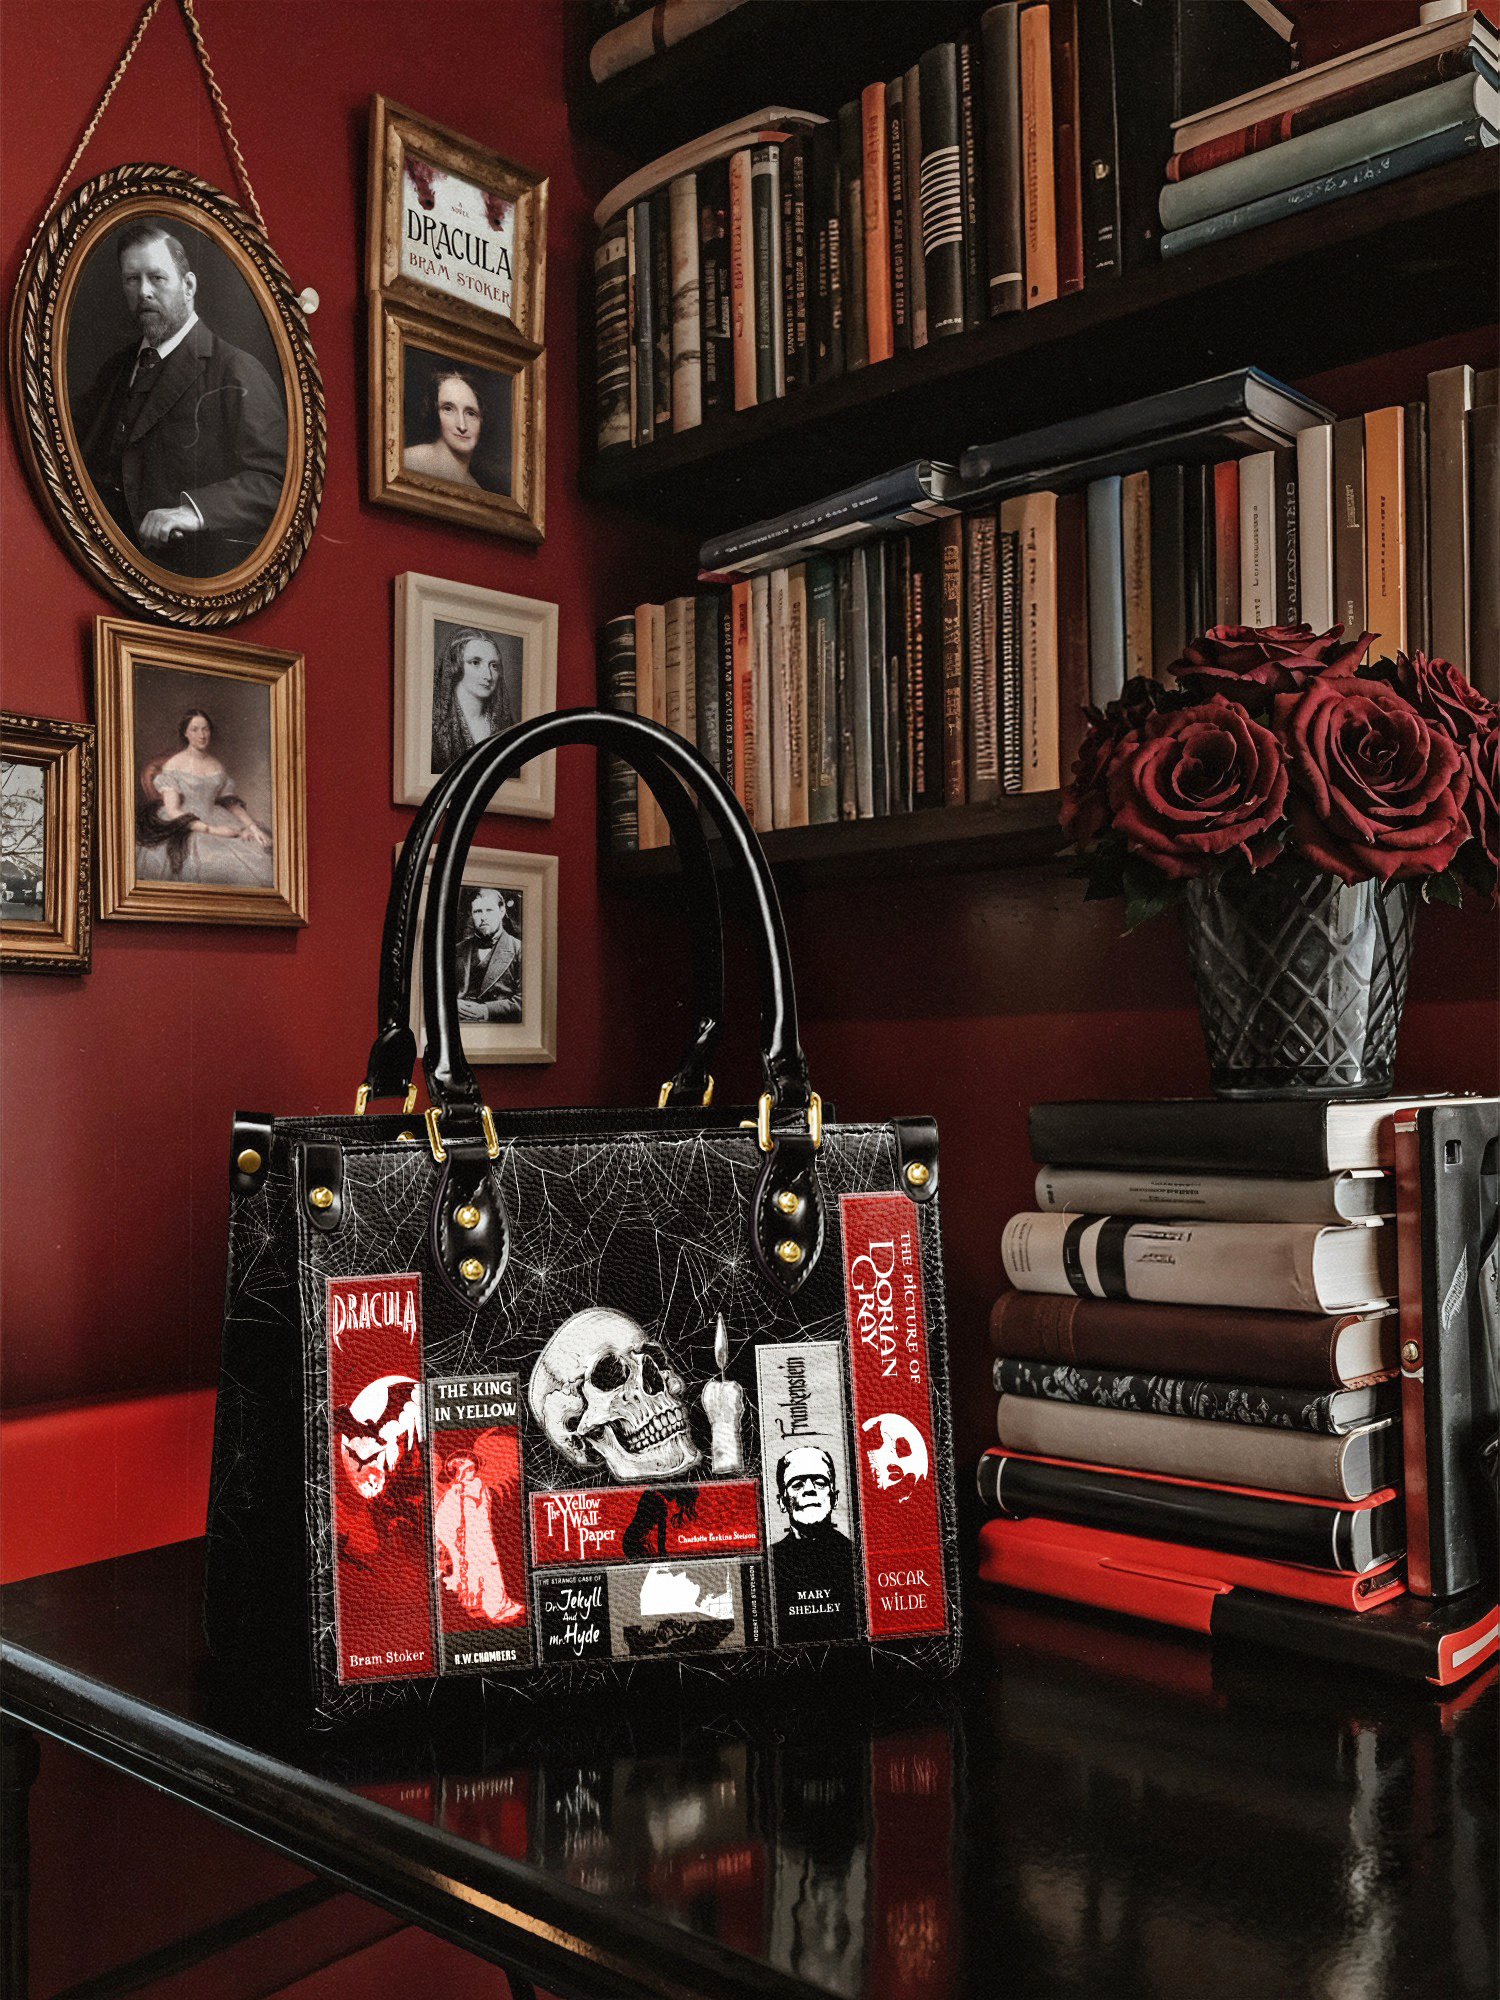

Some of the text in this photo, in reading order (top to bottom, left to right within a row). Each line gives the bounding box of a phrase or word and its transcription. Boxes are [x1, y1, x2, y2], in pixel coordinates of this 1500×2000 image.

[451, 205, 470, 219] NOVEL
[407, 208, 513, 281] DRACULA
[409, 252, 512, 309] BRAM STOKER
[851, 1254, 879, 1351] GRAY
[869, 1238, 899, 1377] DORIAN
[901, 1231, 921, 1384] THE PICTURE OF
[332, 1290, 417, 1352] DRACULA
[437, 1380, 512, 1399] THE KING
[774, 1356, 823, 1441] Frankenstein
[434, 1402, 518, 1422] IN YELLOW
[543, 1493, 601, 1552] The Yellow
[577, 1527, 616, 1560] Paper
[551, 1576, 577, 1585] STRANGE
[577, 1575, 593, 1584] CASE
[796, 1588, 831, 1600] MARY
[877, 1570, 932, 1588] OSCAR
[556, 1586, 603, 1620] Jekyll
[788, 1602, 841, 1616] SHELLEY
[881, 1592, 928, 1612] WILDE
[564, 1622, 600, 1657] Hyde
[752, 1618, 760, 1642] ROBERT
[349, 1650, 425, 1668] Bram Stoker
